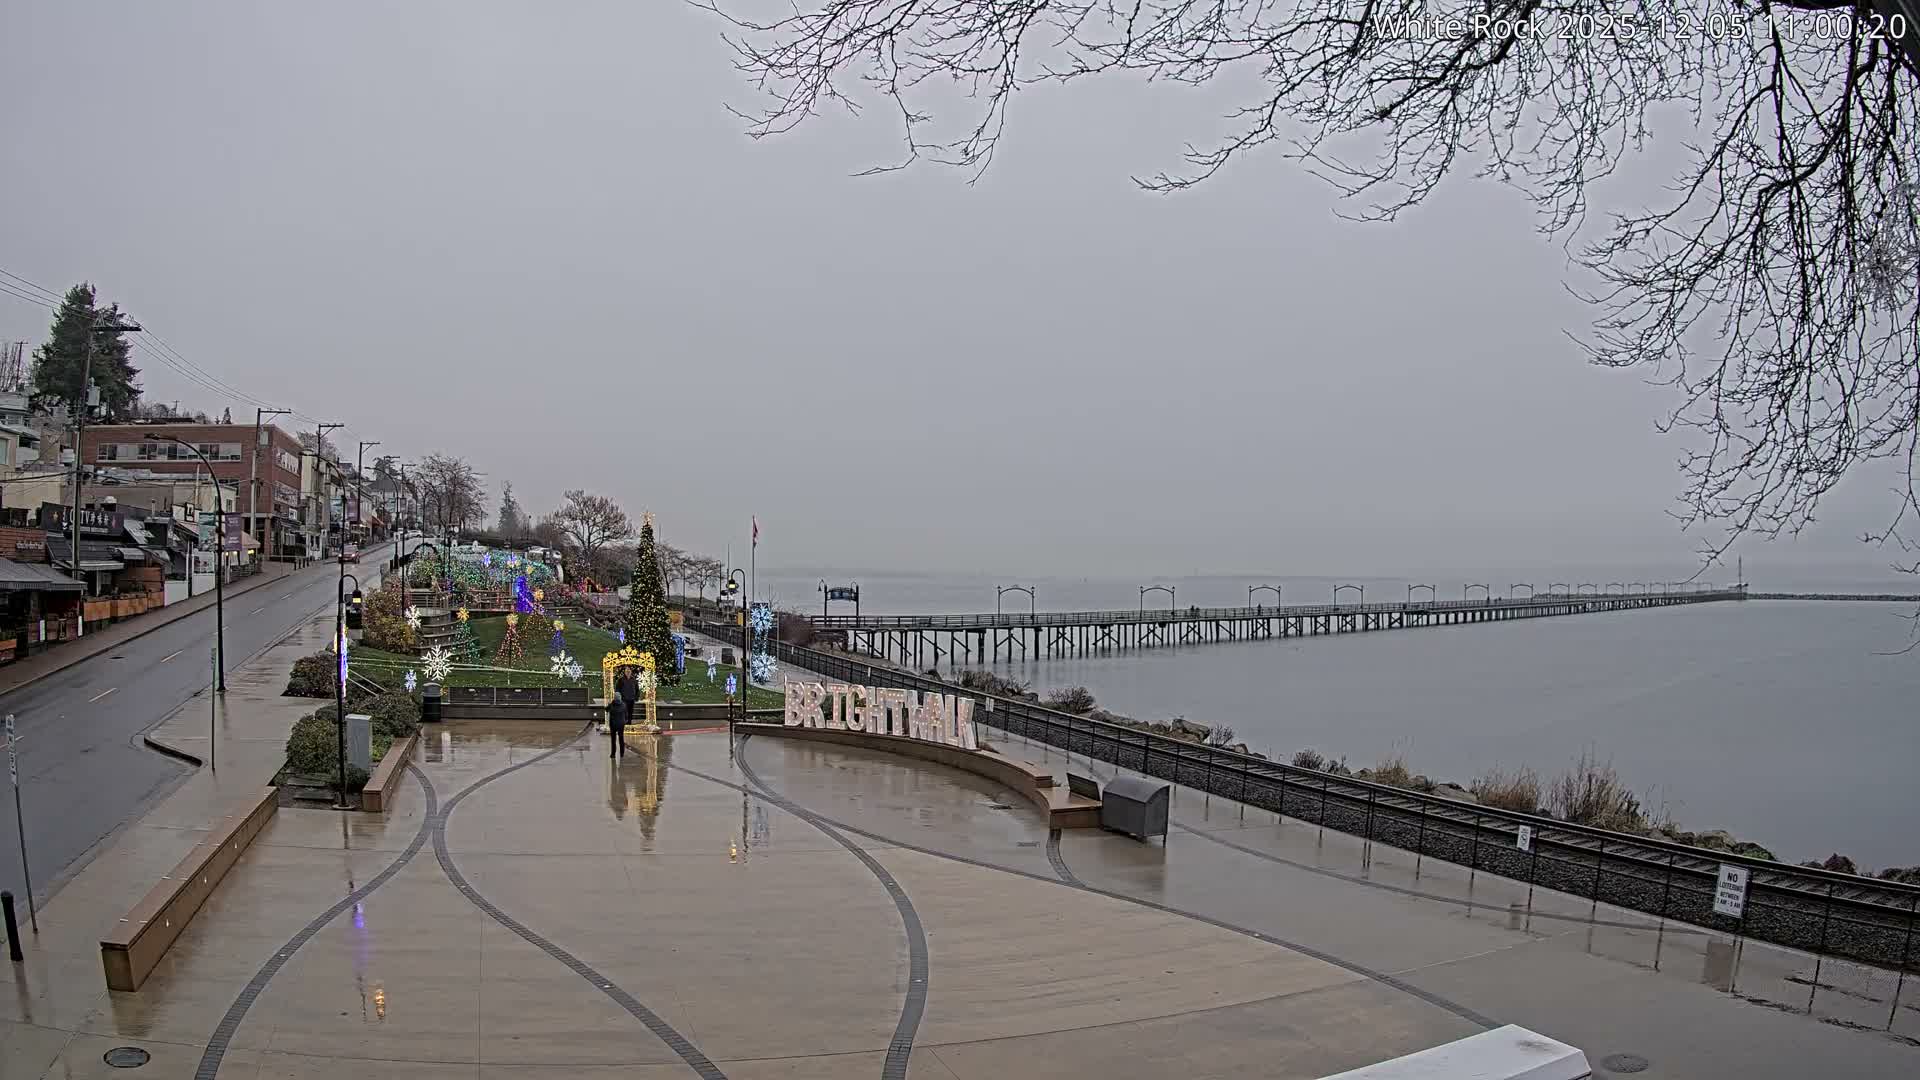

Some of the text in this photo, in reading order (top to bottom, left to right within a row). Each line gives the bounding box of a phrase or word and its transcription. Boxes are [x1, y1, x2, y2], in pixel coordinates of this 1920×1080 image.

[1727, 872, 1738, 883] NO
[1719, 881, 1744, 893] LOITERING
[1720, 891, 1739, 900] BETWEEN
